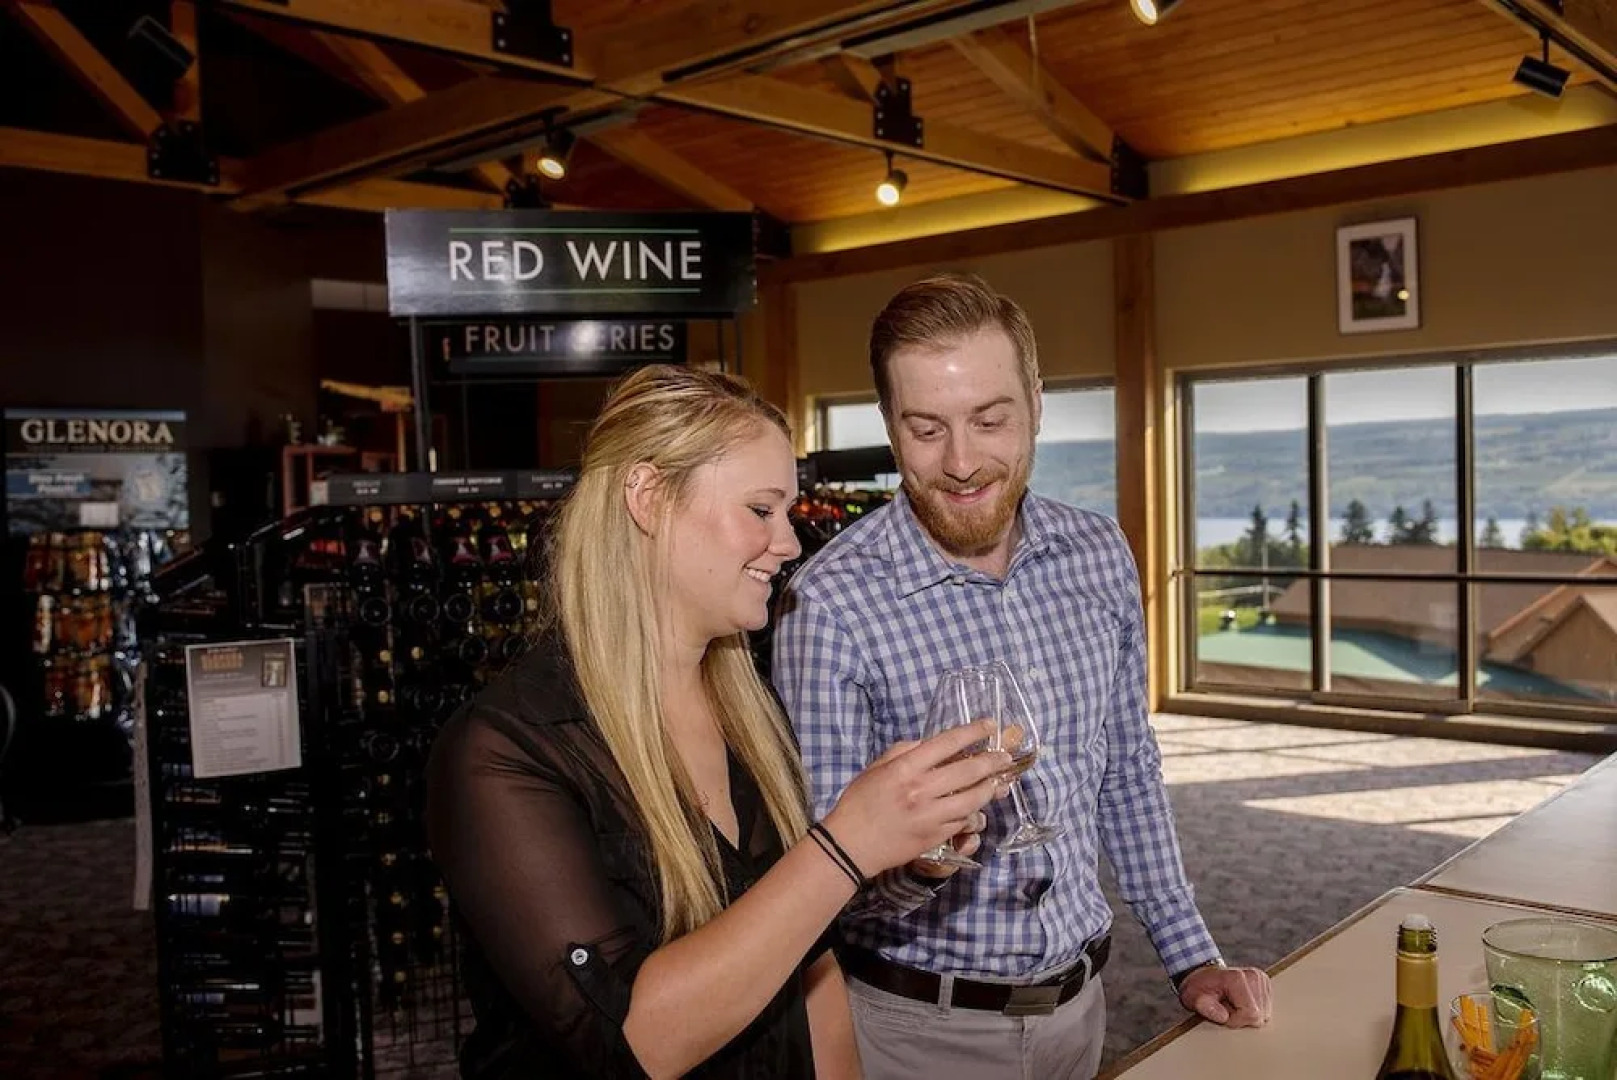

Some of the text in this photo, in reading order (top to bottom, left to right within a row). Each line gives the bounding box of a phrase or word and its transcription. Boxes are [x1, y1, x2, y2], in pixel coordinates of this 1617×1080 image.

[449, 240, 702, 281] RED WINE
[465, 325, 555, 352] FRUIT
[20, 418, 174, 444] GLENORA
